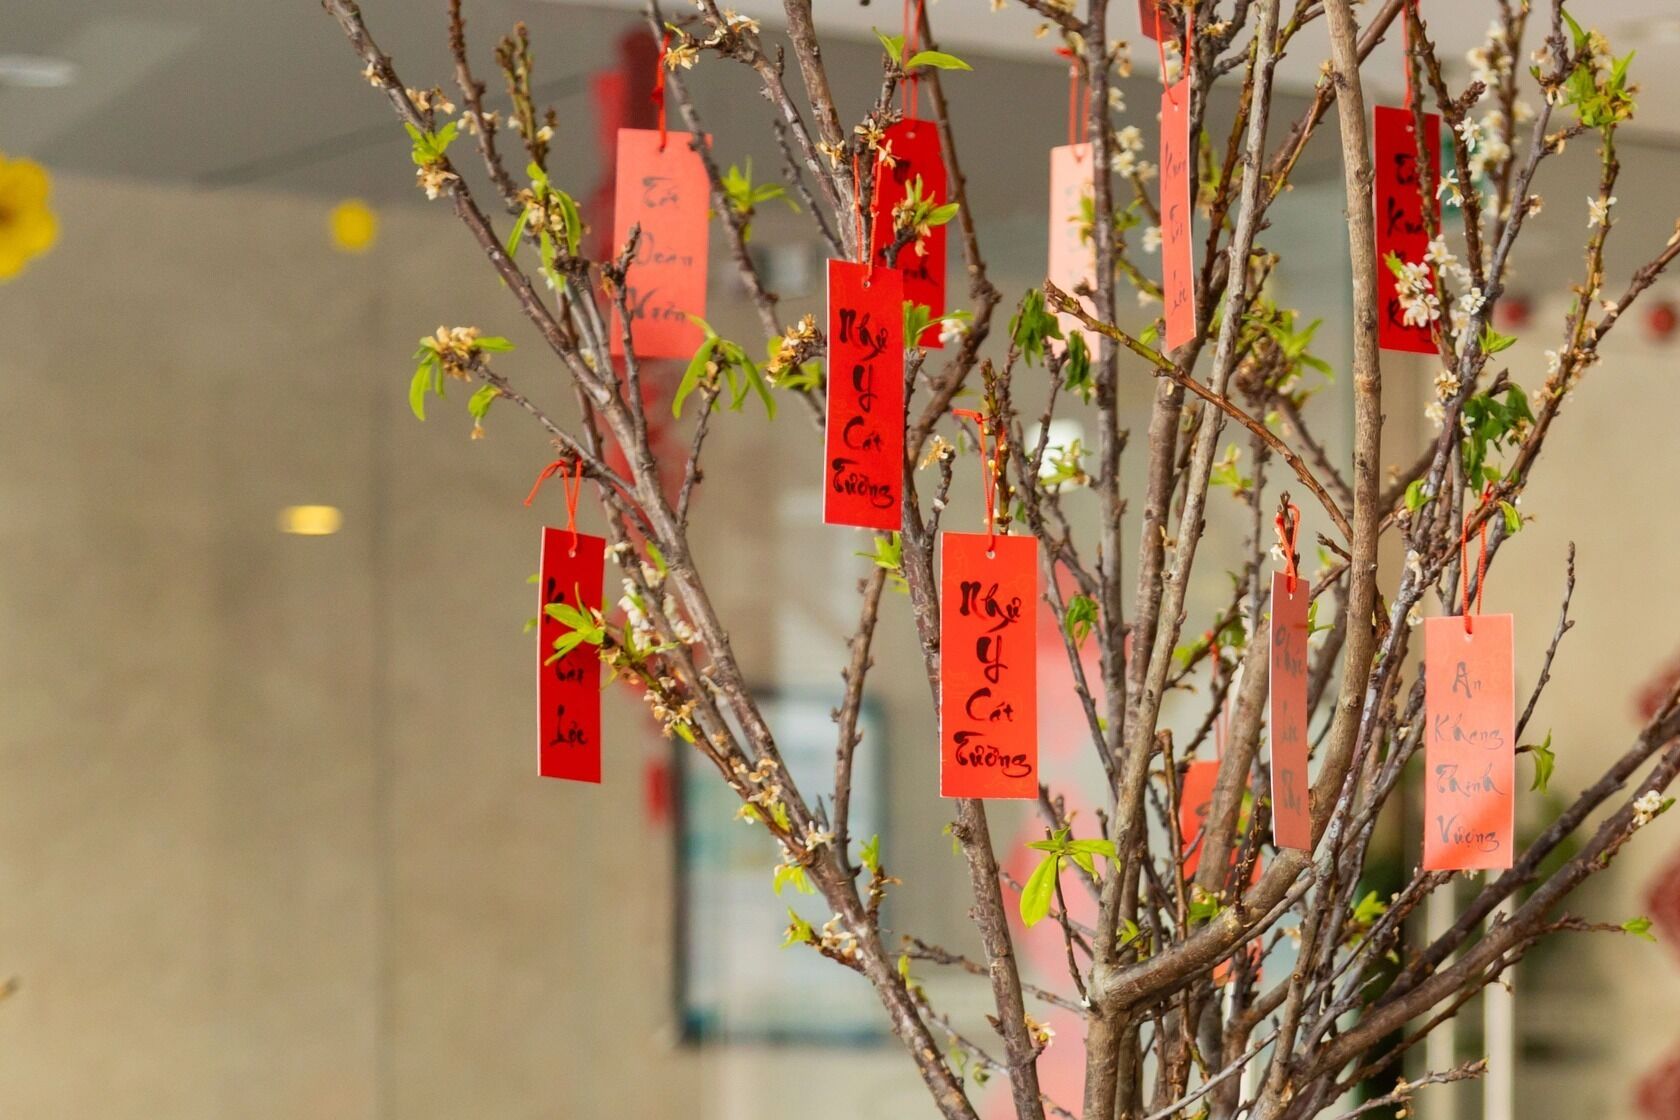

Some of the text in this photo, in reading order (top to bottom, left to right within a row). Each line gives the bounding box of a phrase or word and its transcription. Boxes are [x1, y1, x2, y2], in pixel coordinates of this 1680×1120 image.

[838, 307, 889, 361] Như
[842, 415, 883, 452] Cát
[831, 457, 895, 510] Tường
[958, 580, 1022, 634] Như
[1452, 660, 1482, 700] An
[965, 686, 1014, 723] Cát
[1433, 713, 1505, 751] Khang
[952, 730, 1033, 779] Tường
